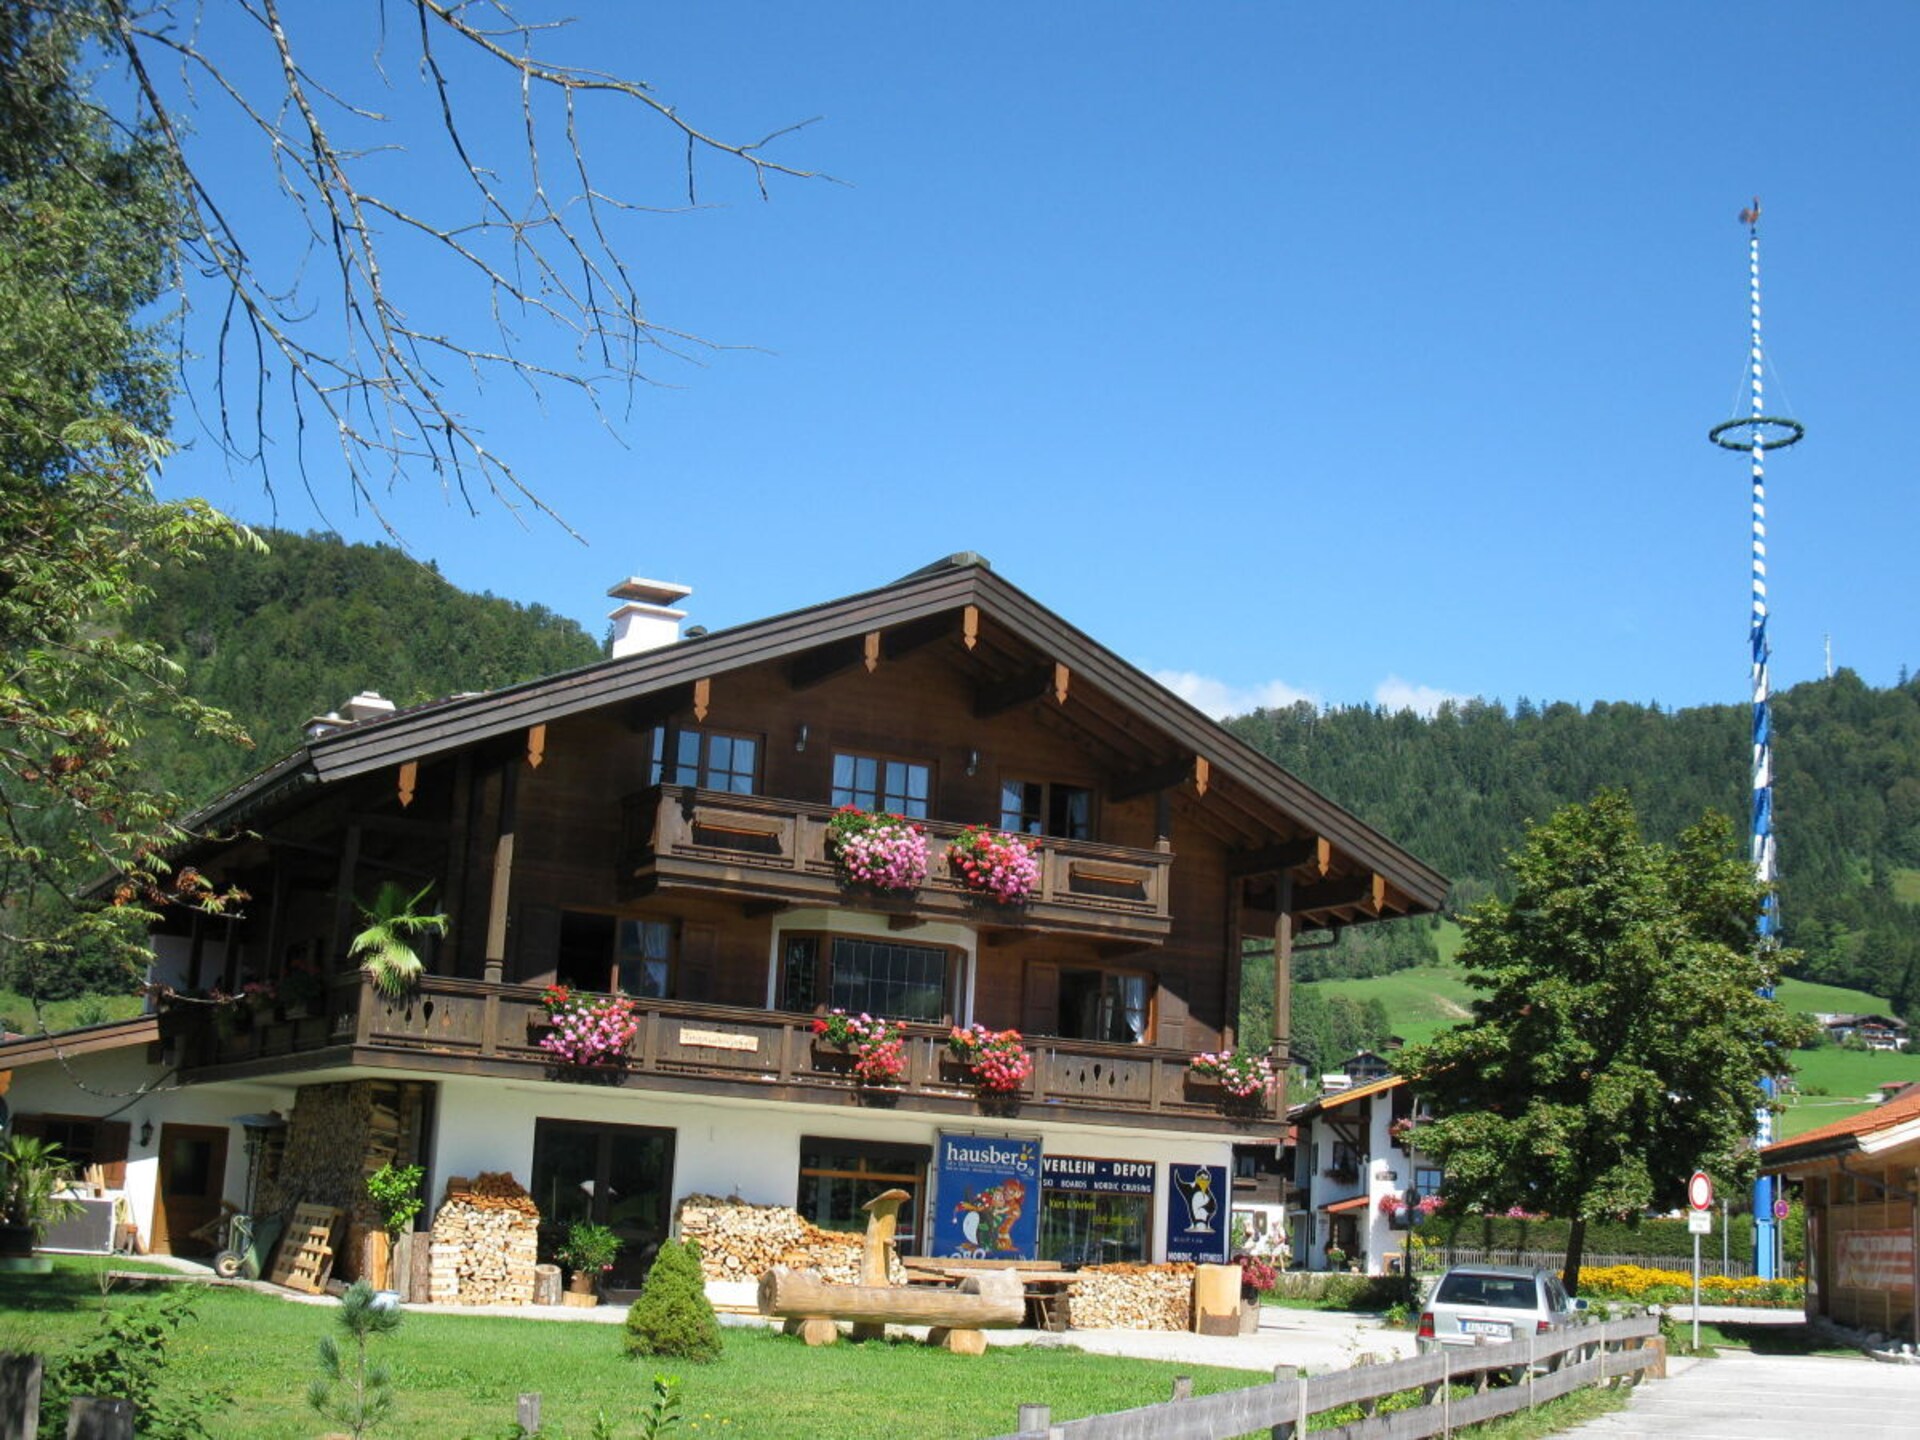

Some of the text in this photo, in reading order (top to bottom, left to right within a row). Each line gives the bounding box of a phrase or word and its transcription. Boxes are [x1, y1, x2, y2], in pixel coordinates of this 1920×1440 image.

[947, 1142, 1027, 1172] hausberg
[1043, 1158, 1096, 1175] VERLEIH
[1112, 1162, 1154, 1178] DEPOT
[1042, 1178, 1054, 1187] SKI
[1061, 1179, 1088, 1189] BOARDS
[1093, 1181, 1120, 1191] NORDIC
